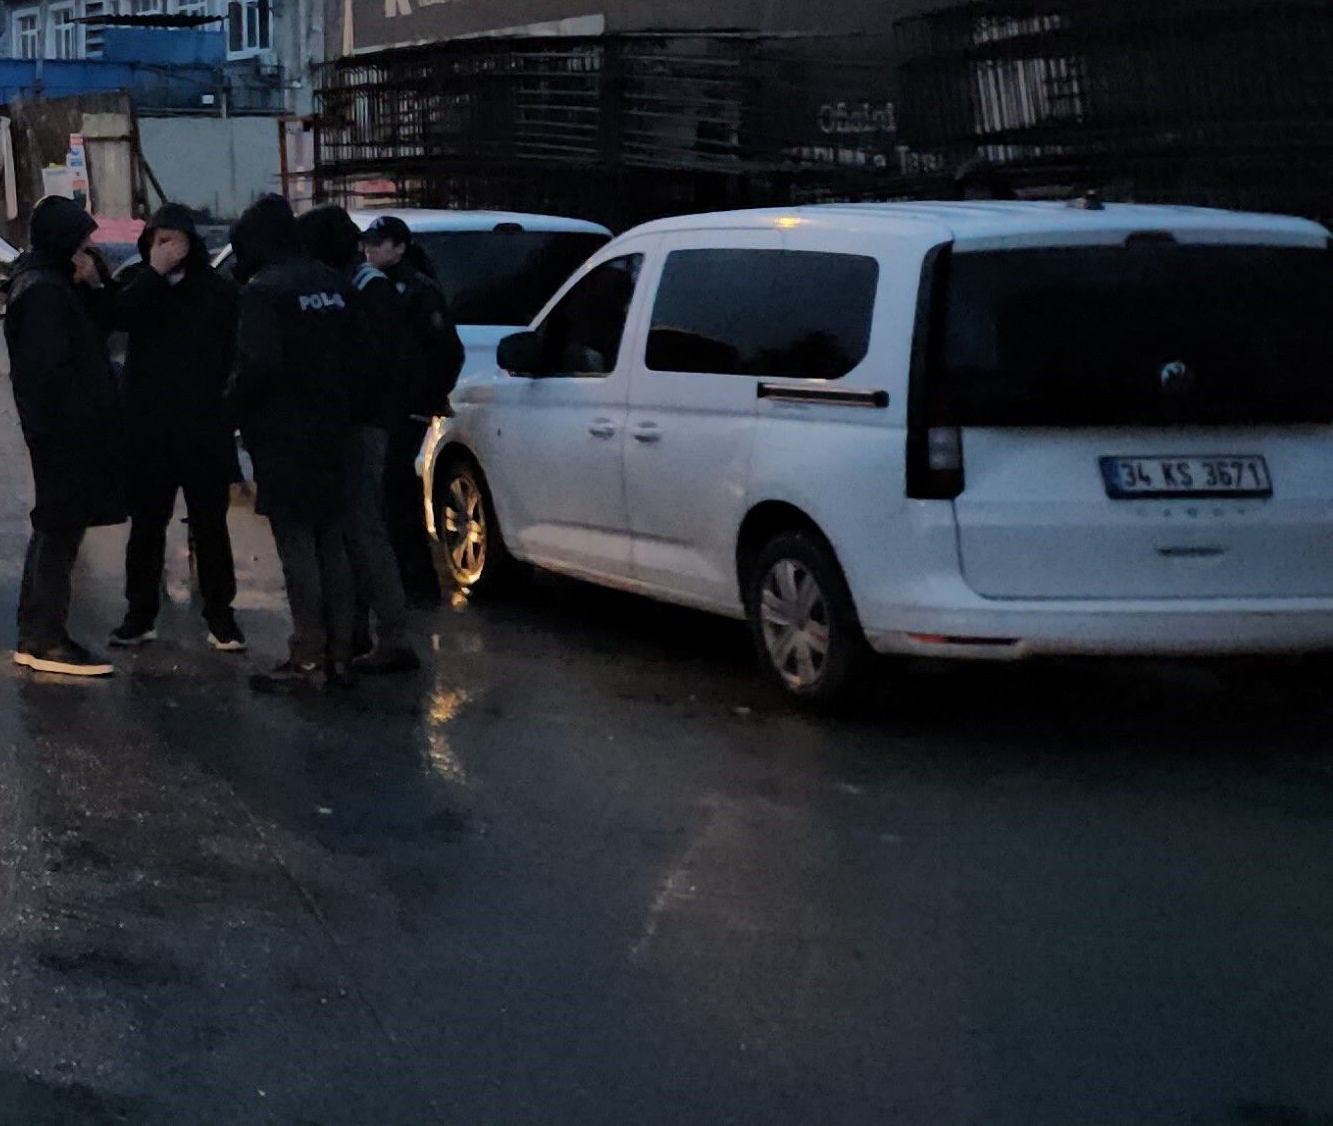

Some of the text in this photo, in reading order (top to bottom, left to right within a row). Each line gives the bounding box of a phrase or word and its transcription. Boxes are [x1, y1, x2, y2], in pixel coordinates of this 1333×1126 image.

[1121, 460, 1263, 487] 34 KS 3671
